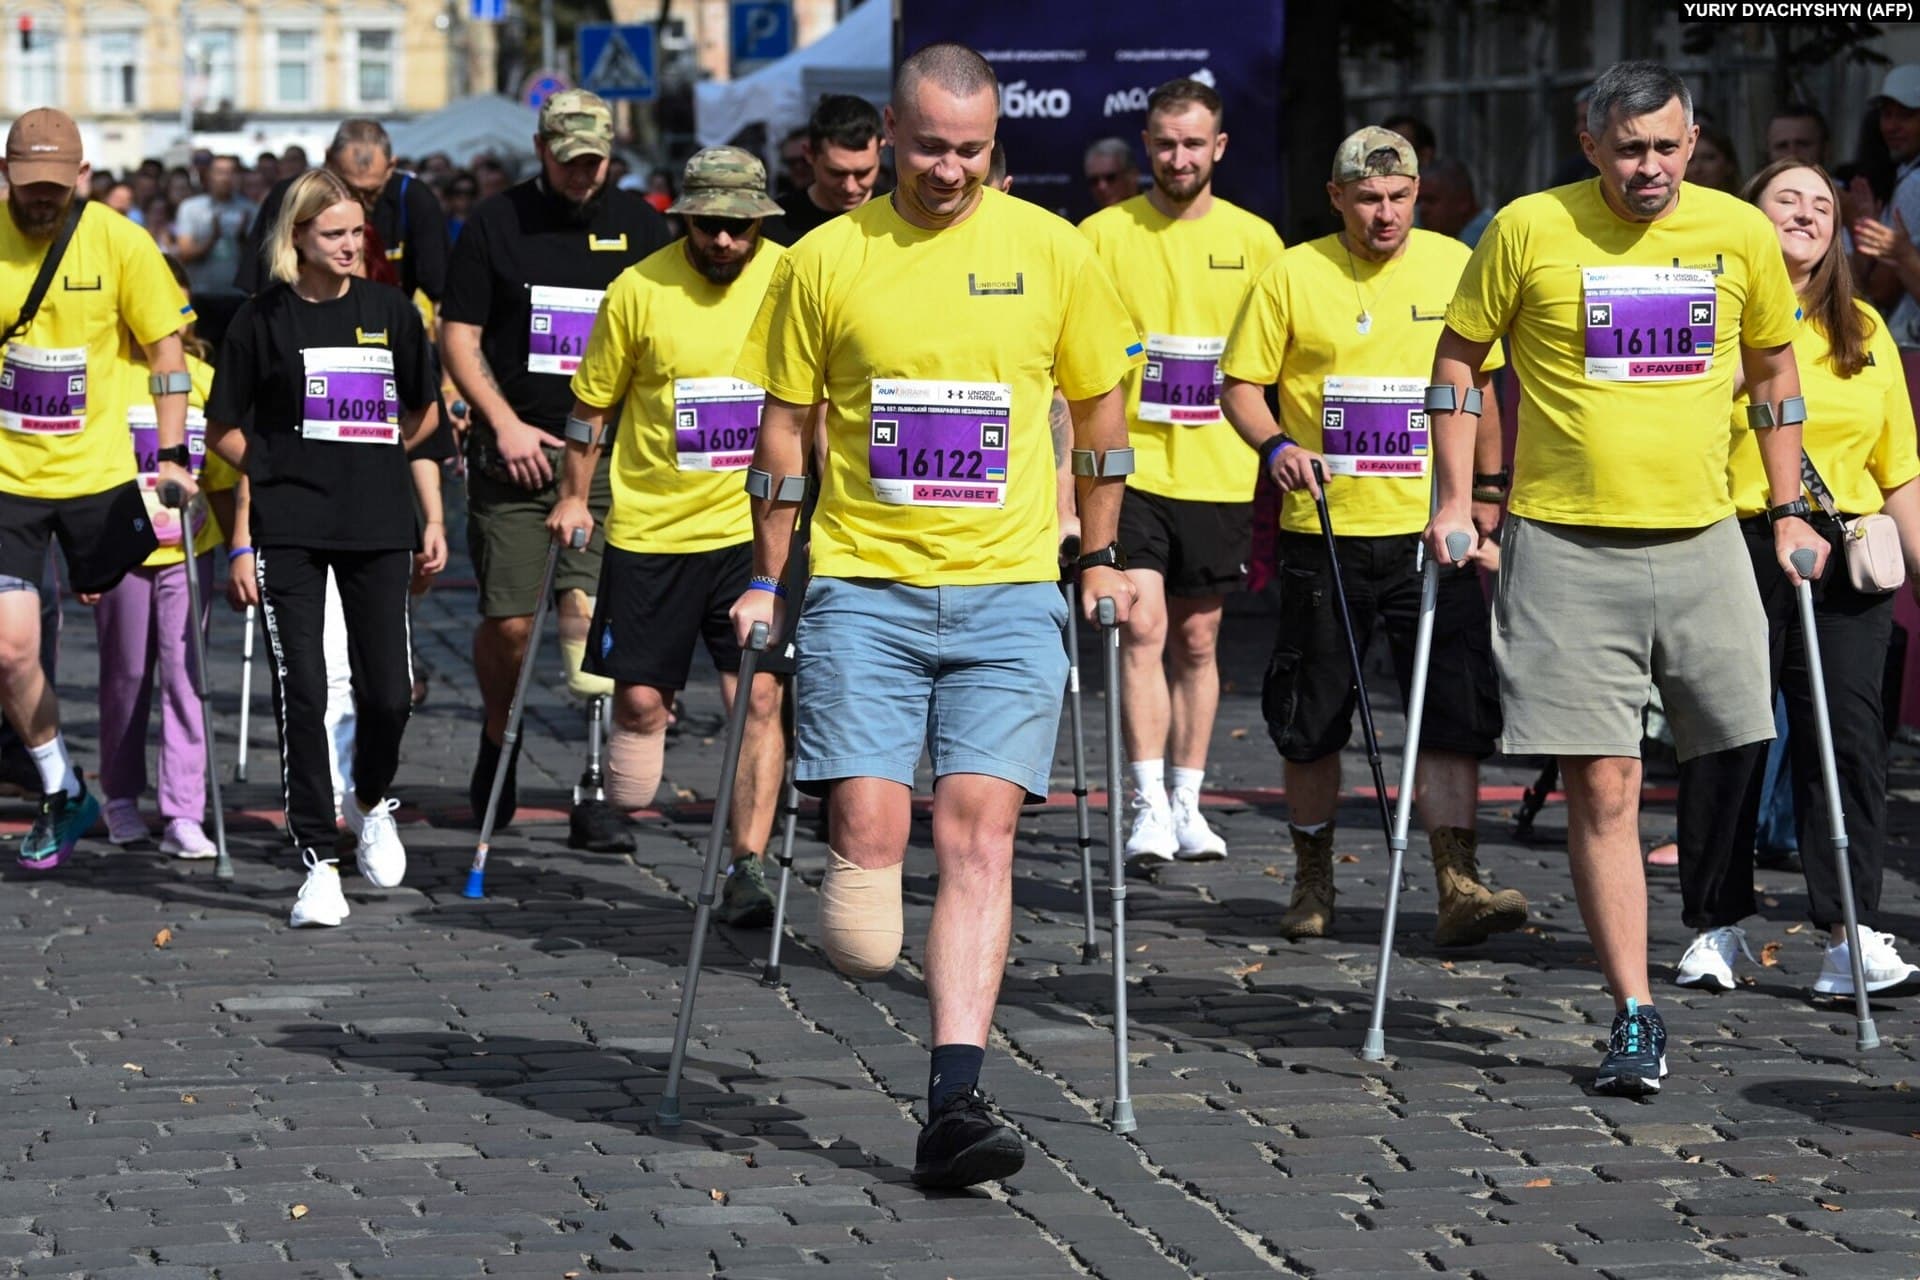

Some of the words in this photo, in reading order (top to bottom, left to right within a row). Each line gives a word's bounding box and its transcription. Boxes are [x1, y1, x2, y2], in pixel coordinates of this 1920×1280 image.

[550, 335, 583, 355] 161
[1613, 327, 1693, 355] 16118
[1646, 363, 1704, 373] FAVBET
[12, 390, 70, 416] 16166
[326, 398, 387, 420] 16098
[697, 427, 759, 452] 16097
[1343, 430, 1411, 454] 16160
[897, 447, 983, 479] 16122
[1371, 461, 1419, 470] FAVBET
[932, 488, 995, 499] FAVBET
